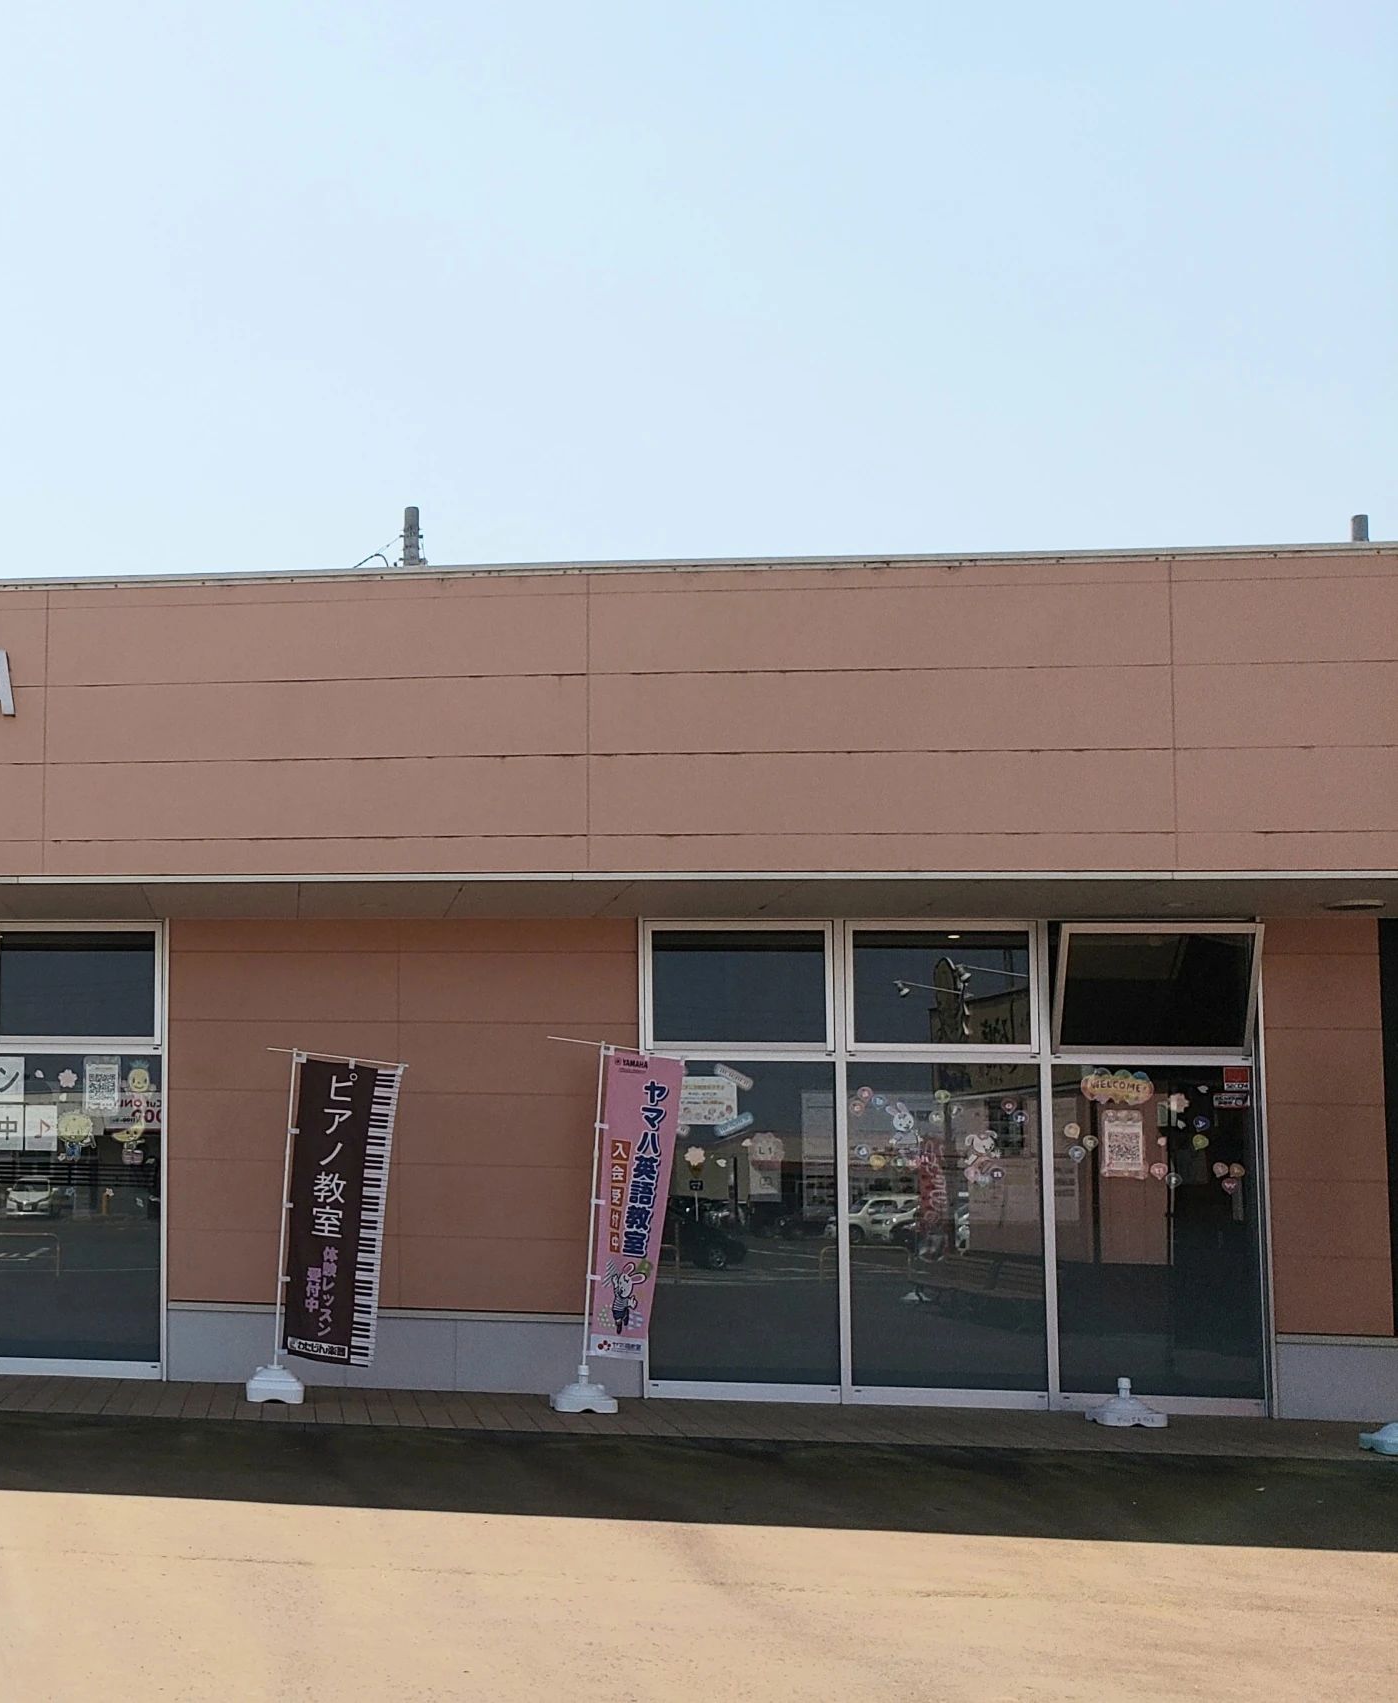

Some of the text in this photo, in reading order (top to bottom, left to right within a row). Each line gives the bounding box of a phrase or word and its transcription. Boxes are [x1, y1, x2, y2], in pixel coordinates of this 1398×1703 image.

[622, 1057, 648, 1069] YAMAHA
[310, 1071, 358, 1240] ピアノ教室
[611, 1140, 629, 1253] 入会受付中
[622, 1080, 669, 1259] ヤマハ英語教室
[304, 1265, 322, 1314] 受付中
[317, 1245, 339, 1338] 体験レッスン
